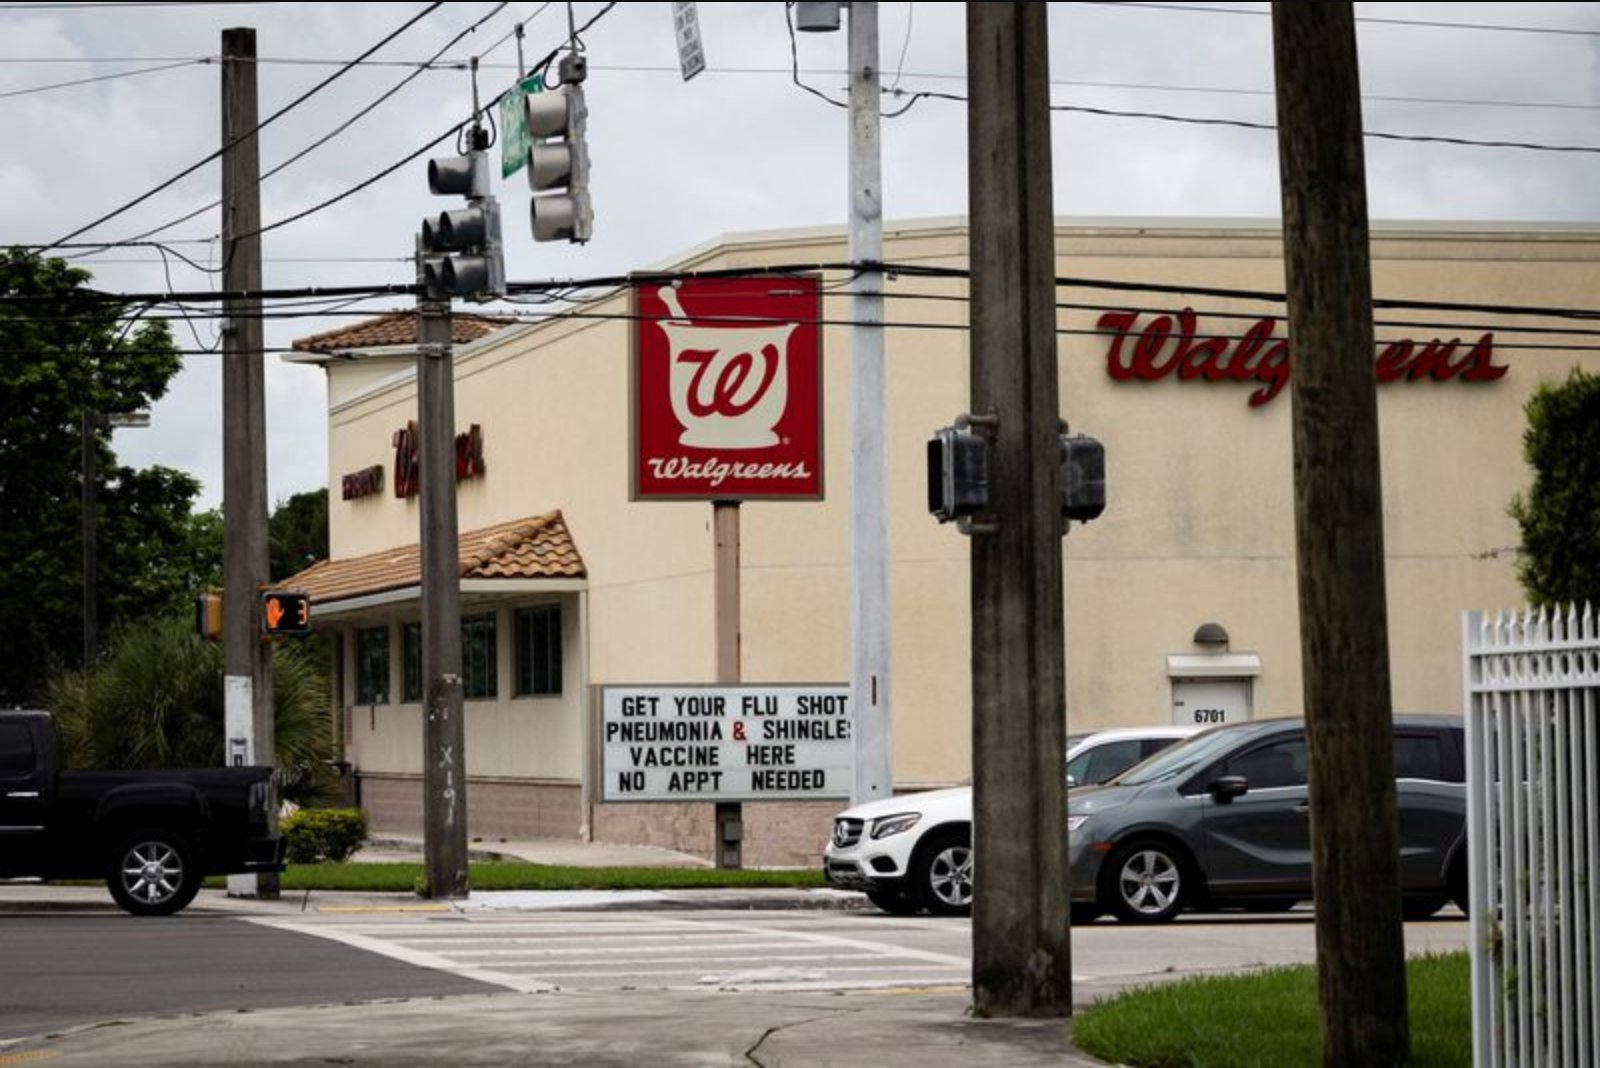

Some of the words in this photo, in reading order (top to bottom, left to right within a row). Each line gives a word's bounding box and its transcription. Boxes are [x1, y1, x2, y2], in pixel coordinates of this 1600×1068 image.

[1096, 306, 1509, 408] Walgens
[676, 343, 779, 417] W
[648, 457, 811, 487] Walgreens
[298, 599, 307, 625] 3
[622, 696, 660, 717] GET
[674, 696, 725, 717] YOUR
[742, 696, 778, 716] FLU
[797, 695, 849, 715] SHOT
[1194, 709, 1225, 723] 6701
[606, 721, 723, 742] PNEUMONIA
[733, 721, 746, 741] &
[763, 719, 851, 740] SHINGLE
[630, 746, 719, 767] VACCINE
[747, 744, 795, 765] HERE
[619, 771, 645, 792] NO
[668, 771, 722, 791] APPT
[752, 769, 825, 790] NEEDED
